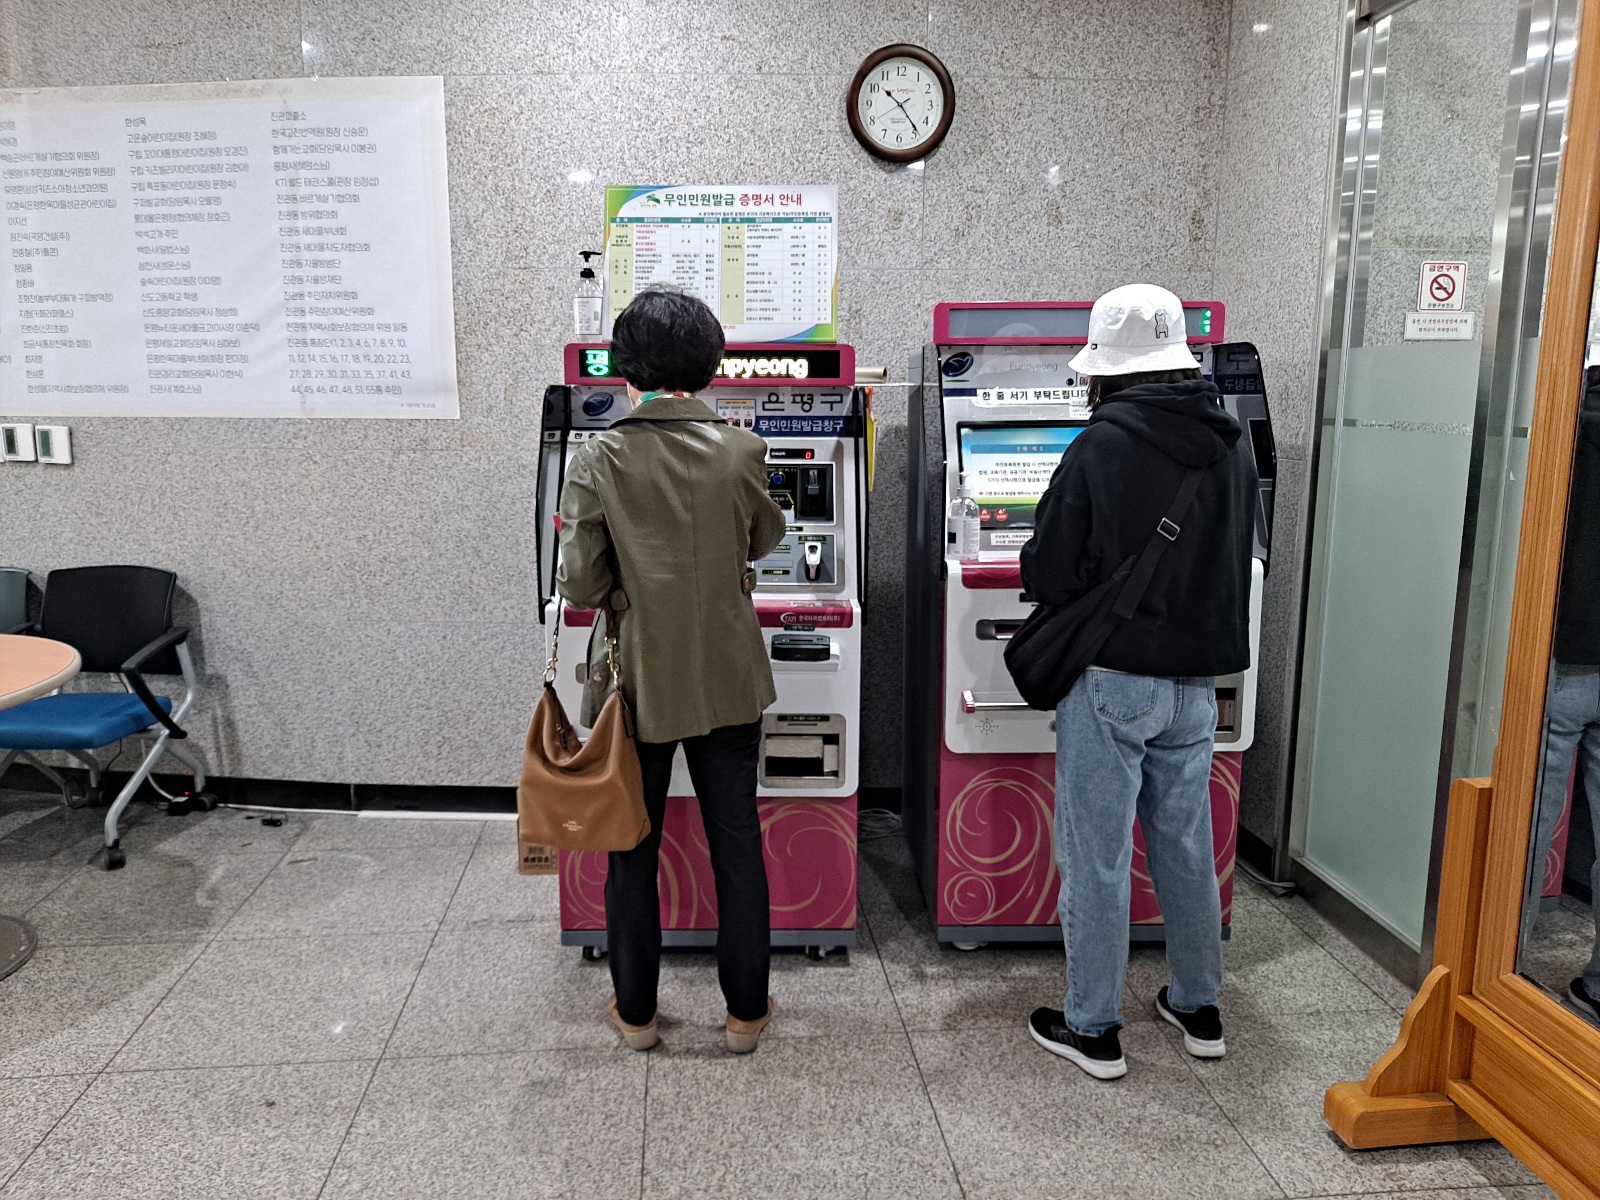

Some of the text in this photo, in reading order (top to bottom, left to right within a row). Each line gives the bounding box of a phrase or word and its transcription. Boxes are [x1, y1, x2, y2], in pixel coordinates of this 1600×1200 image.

[881, 71, 889, 81] 11
[896, 66, 907, 77] 12
[916, 72, 920, 82] 1
[870, 83, 879, 93] 10
[925, 84, 931, 94] 2
[866, 100, 872, 109] 9
[928, 100, 933, 111] 3
[271, 111, 307, 121] 진관파출소
[869, 116, 876, 126] 8
[922, 116, 929, 126] 4
[881, 129, 887, 139] 7
[896, 133, 902, 144] 6
[911, 130, 917, 140] 5
[128, 150, 142, 159] 구립
[130, 166, 144, 175] 구립
[131, 182, 145, 191] 구립
[277, 194, 360, 204] 진관동 바르게살기협의회
[663, 193, 735, 207] 무인민원발급
[738, 193, 774, 207] 증명서
[779, 193, 802, 207] 안내
[278, 210, 299, 220] 진관동
[279, 227, 347, 236] 진관동 새마을부녀회
[280, 243, 370, 252] 진관동 새마을지도자협의회
[282, 259, 303, 268] 진관동
[283, 275, 304, 284] 진관동
[183, 293, 197, 301] 학생
[284, 291, 305, 300] 진관동
[285, 307, 306, 316] 진관동
[286, 322, 307, 332] 진관동
[287, 339, 308, 347] 진관동
[716, 358, 808, 378] npyeong
[1010, 362, 1058, 372] Eunpyeong
[982, 391, 991, 401] 한
[997, 391, 1004, 401] 줄
[1010, 391, 1028, 401] 서기
[762, 393, 843, 413] 은평구
[759, 420, 844, 432] 무인민원발급창구
[805, 451, 811, 459] 0
